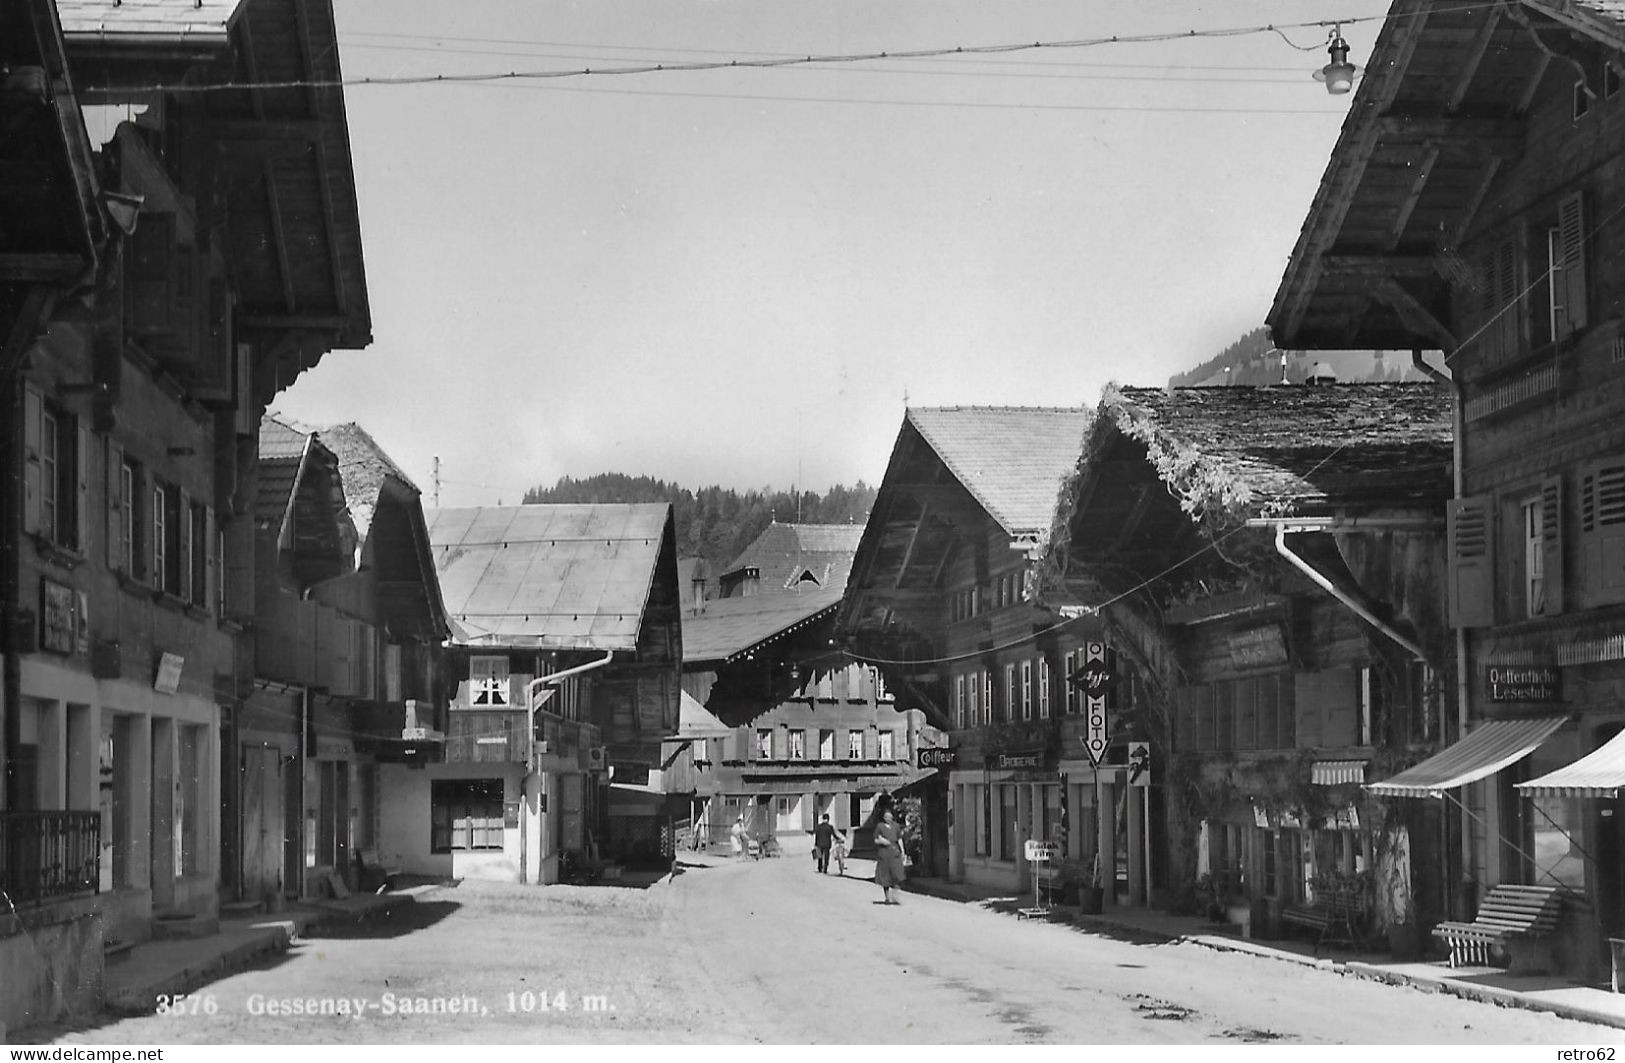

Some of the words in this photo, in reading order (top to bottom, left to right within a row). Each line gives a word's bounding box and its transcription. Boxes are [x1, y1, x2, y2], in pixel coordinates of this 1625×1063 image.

[1078, 670, 1110, 689] Agfa
[1090, 702, 1104, 751] FOTO
[920, 750, 956, 766] Coiffeur
